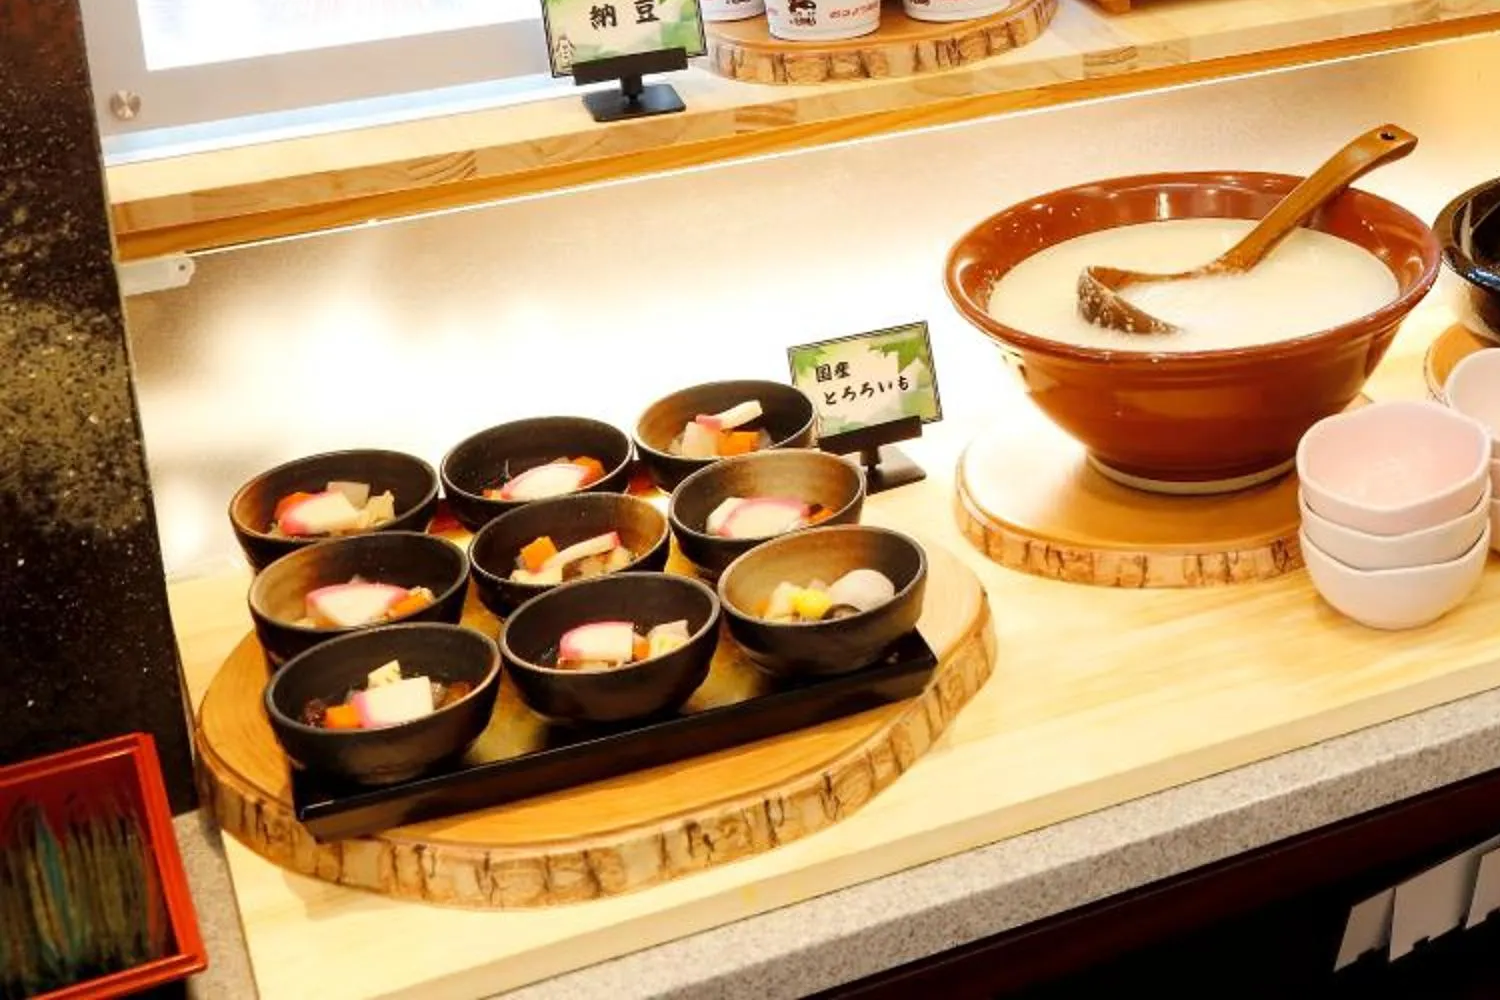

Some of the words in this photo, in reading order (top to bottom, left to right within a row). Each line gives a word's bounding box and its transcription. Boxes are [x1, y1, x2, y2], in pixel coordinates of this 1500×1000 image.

[815, 361, 851, 383] 国産
[823, 375, 910, 406] とろろいも
